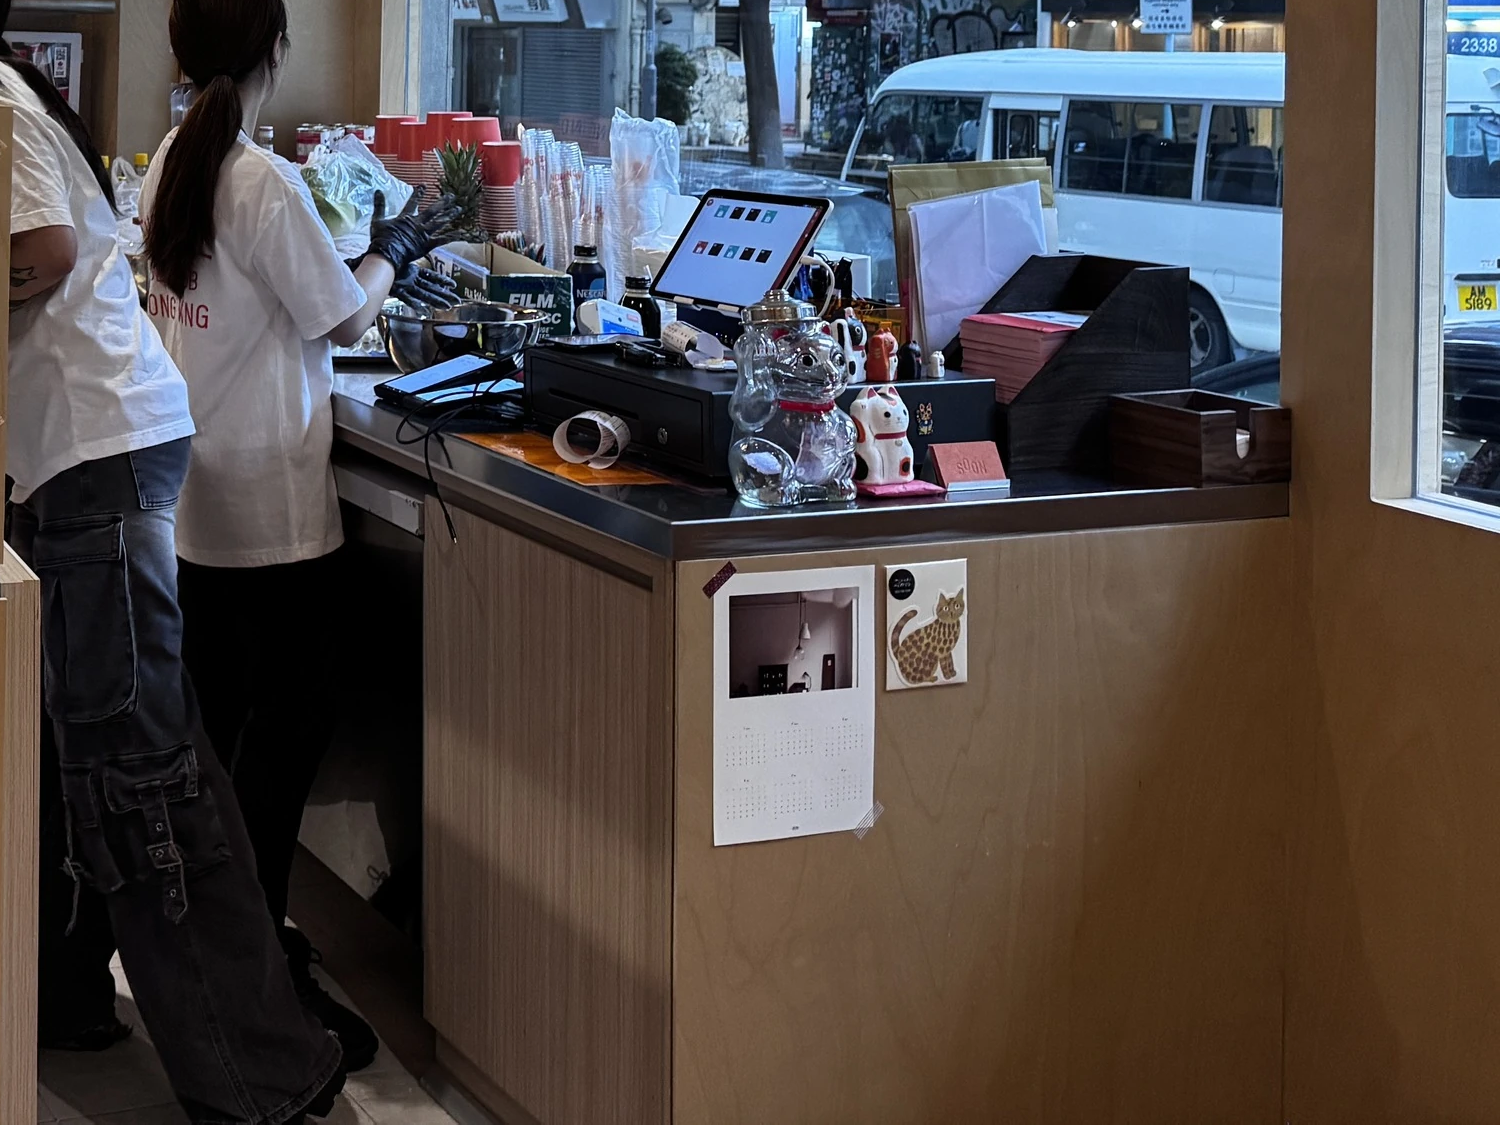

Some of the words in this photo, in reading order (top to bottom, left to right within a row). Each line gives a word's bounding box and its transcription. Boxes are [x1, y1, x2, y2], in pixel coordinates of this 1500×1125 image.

[1461, 37, 1498, 53] 2338
[1470, 285, 1486, 298] AM
[957, 458, 987, 474] SOON
